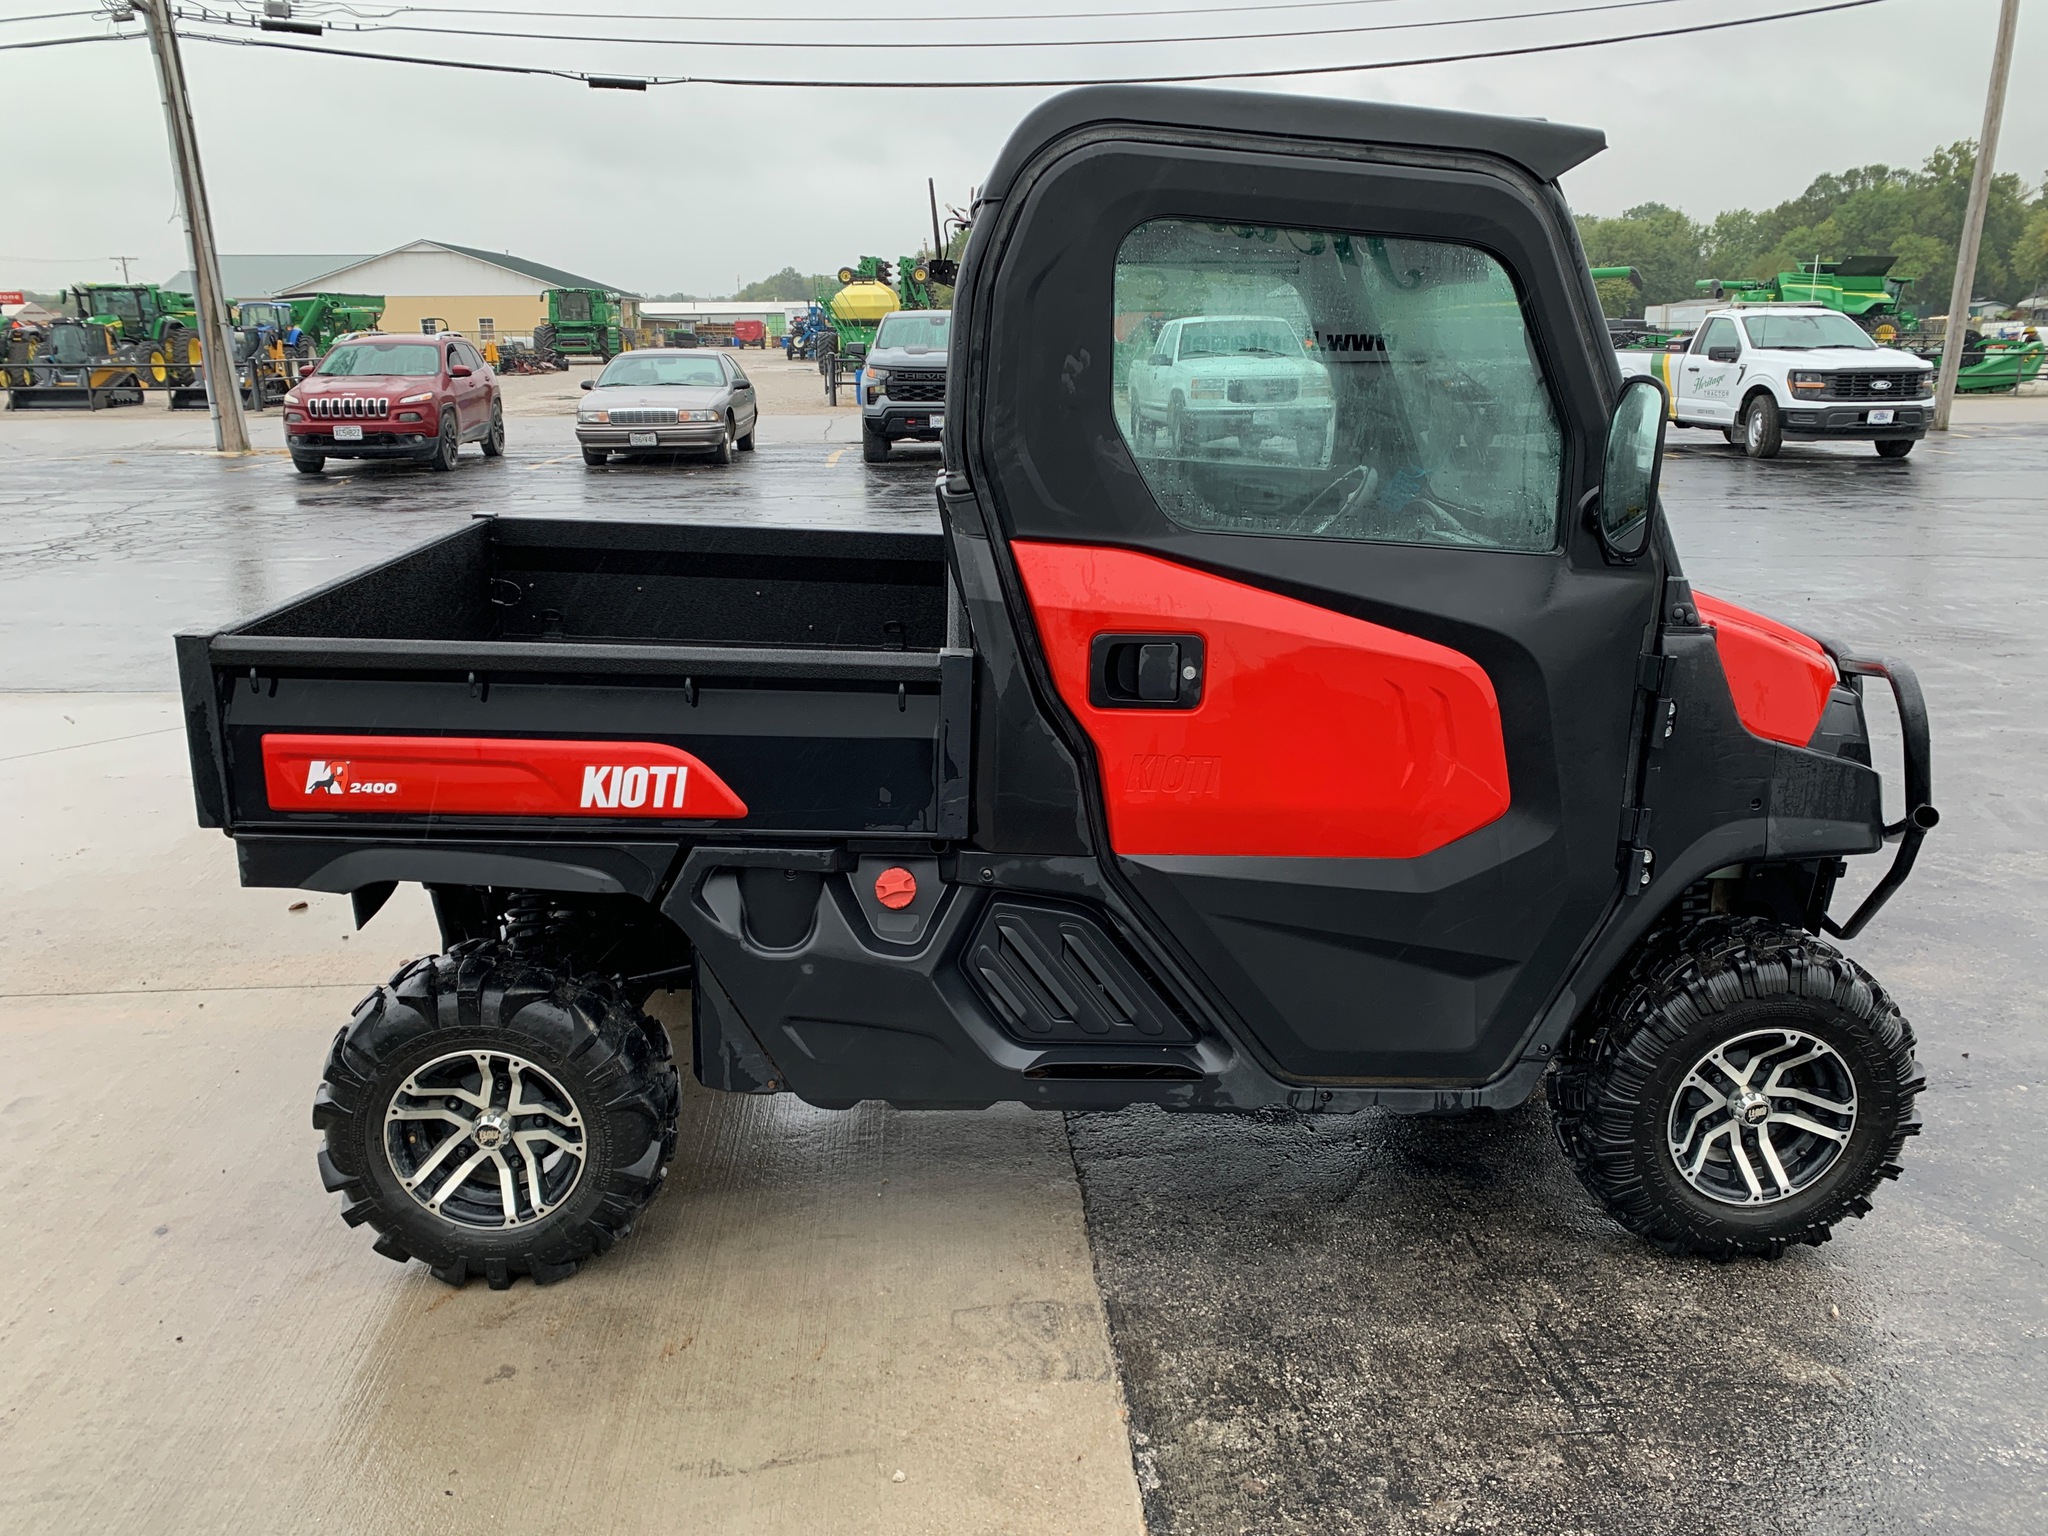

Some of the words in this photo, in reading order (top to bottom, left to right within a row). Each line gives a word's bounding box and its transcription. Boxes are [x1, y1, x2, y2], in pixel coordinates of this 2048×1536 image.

[1692, 374, 1726, 394] Heritage
[349, 782, 397, 794] 2400
[580, 765, 688, 809] KIOTI
[1124, 754, 1222, 793] KIOTI
